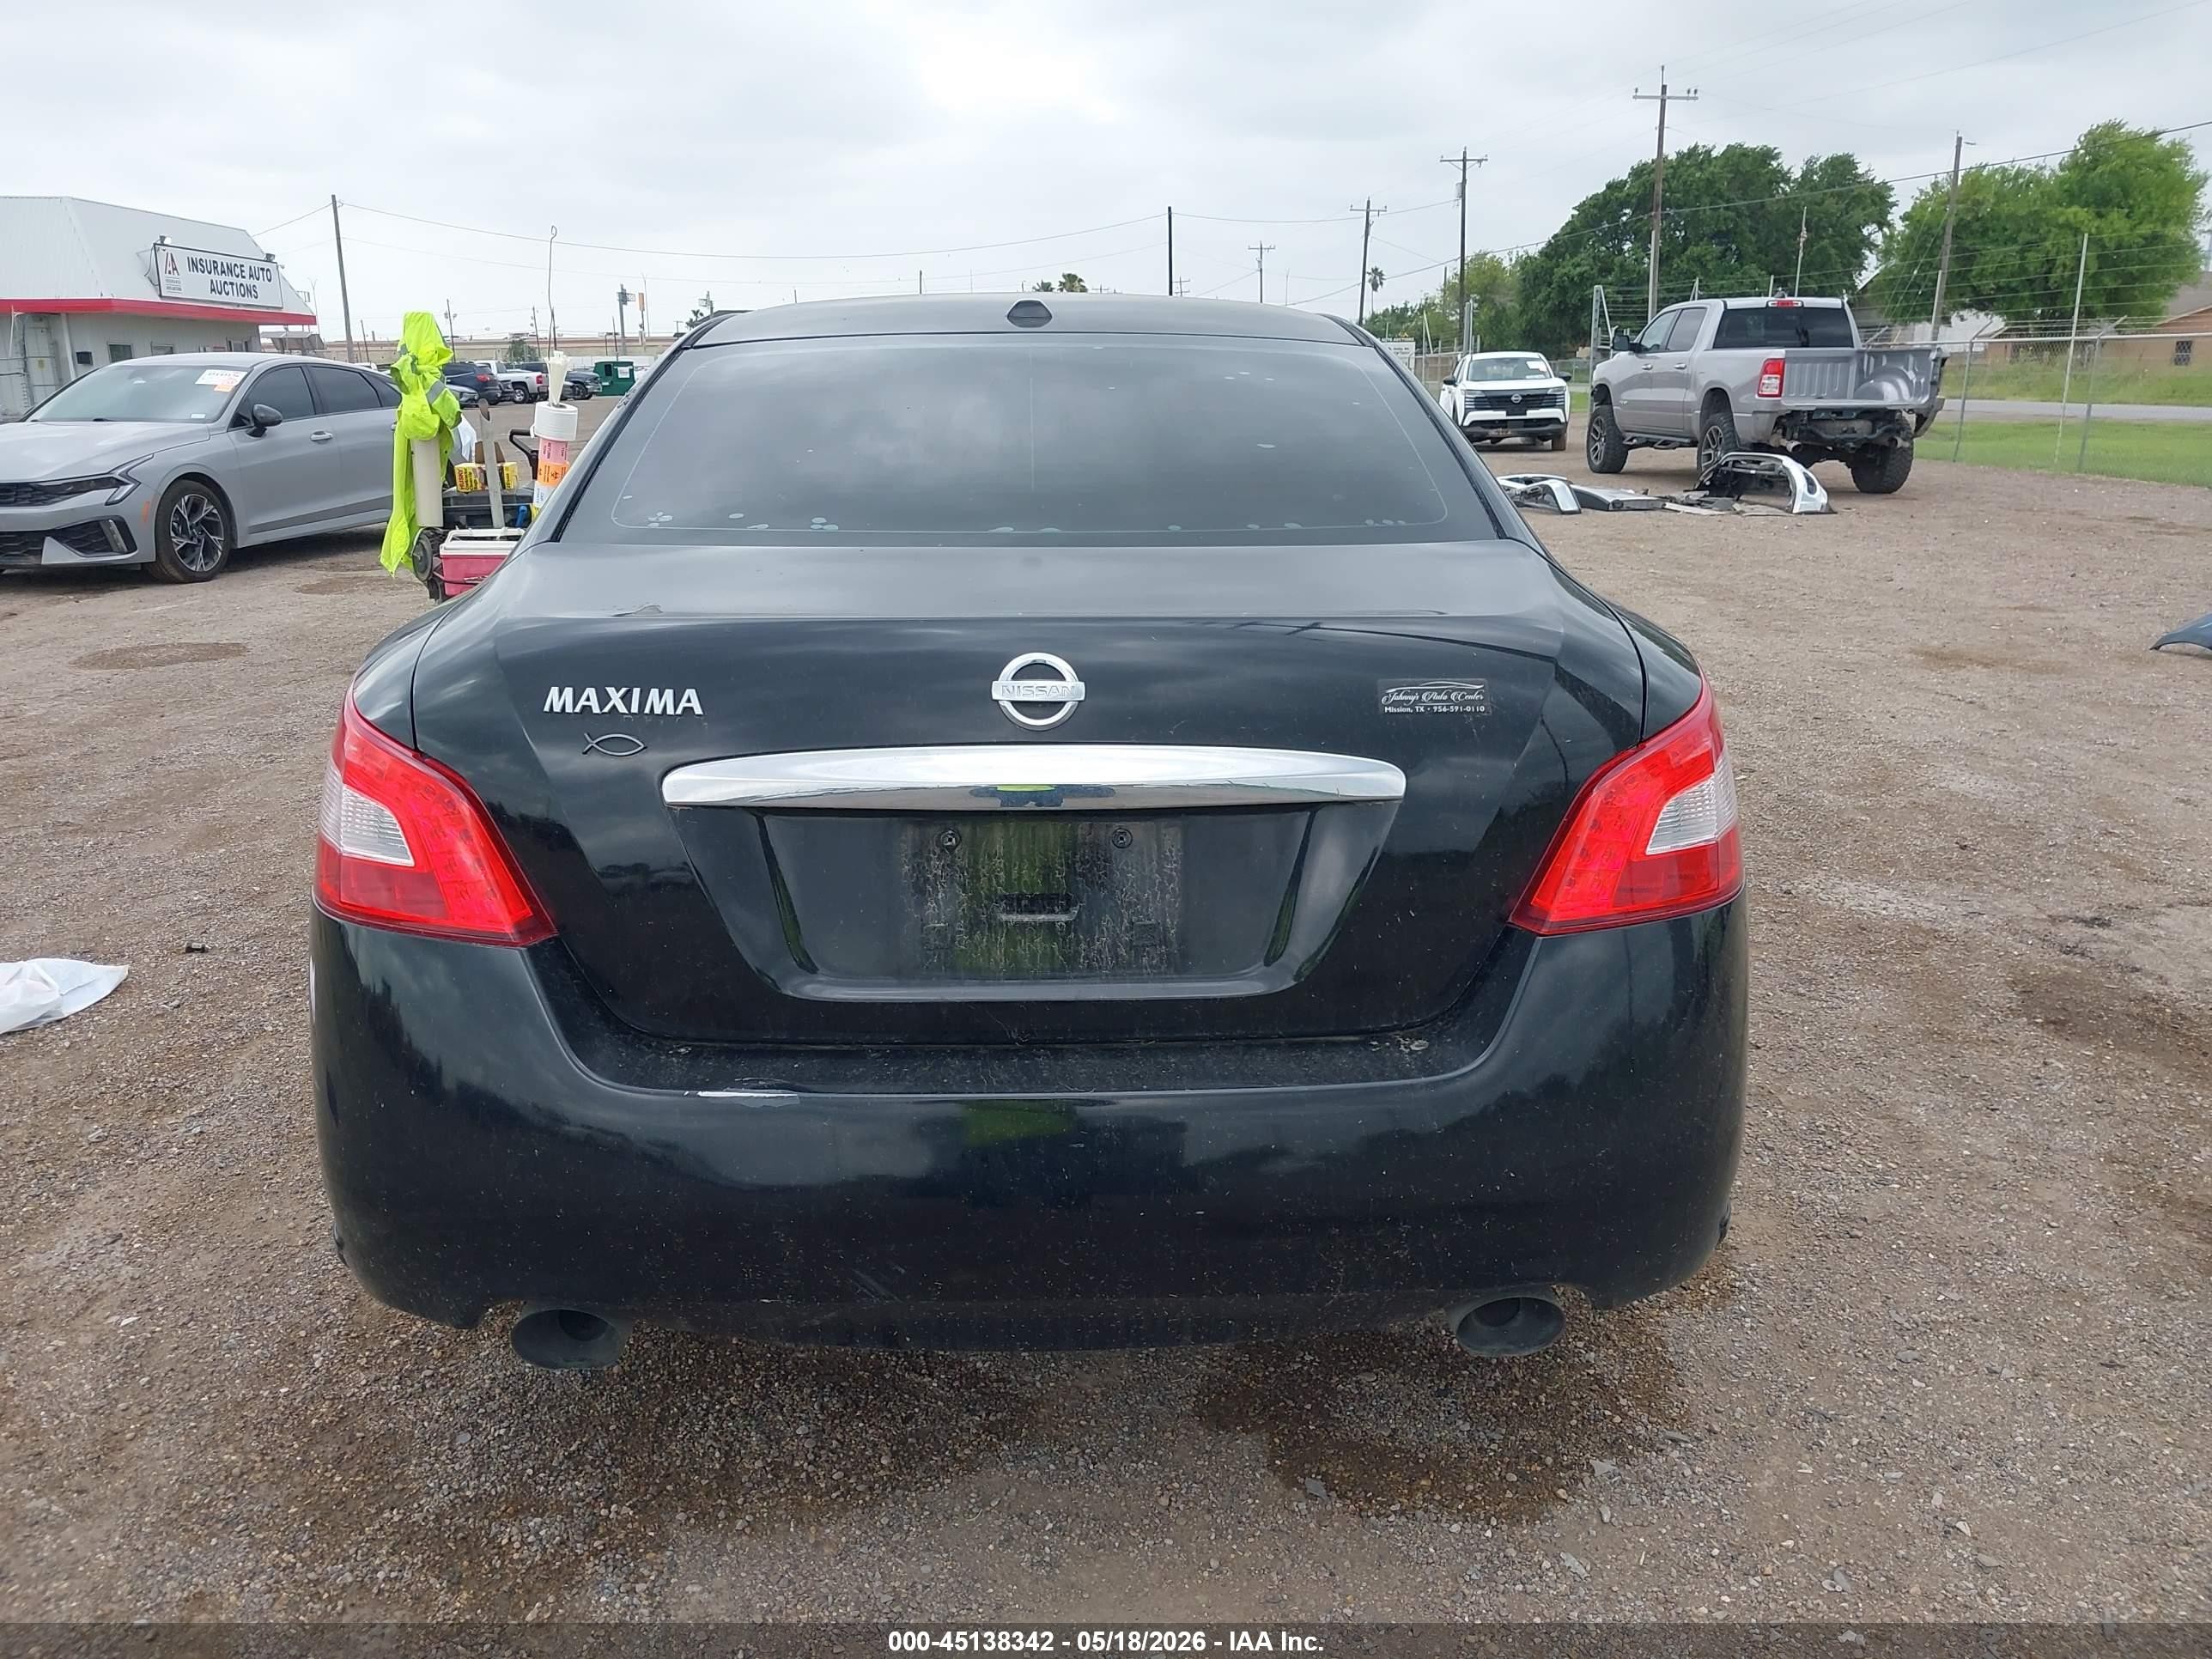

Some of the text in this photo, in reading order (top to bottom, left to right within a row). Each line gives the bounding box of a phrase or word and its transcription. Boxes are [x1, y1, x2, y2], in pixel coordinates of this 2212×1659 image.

[186, 256, 272, 283] INSURANCE AUTO
[210, 279, 258, 299] AUCTIONS
[544, 686, 703, 715] MAXIMA
[1001, 685, 1075, 697] NISSAN
[1421, 690, 1451, 702] Auto
[1450, 690, 1484, 702] Center
